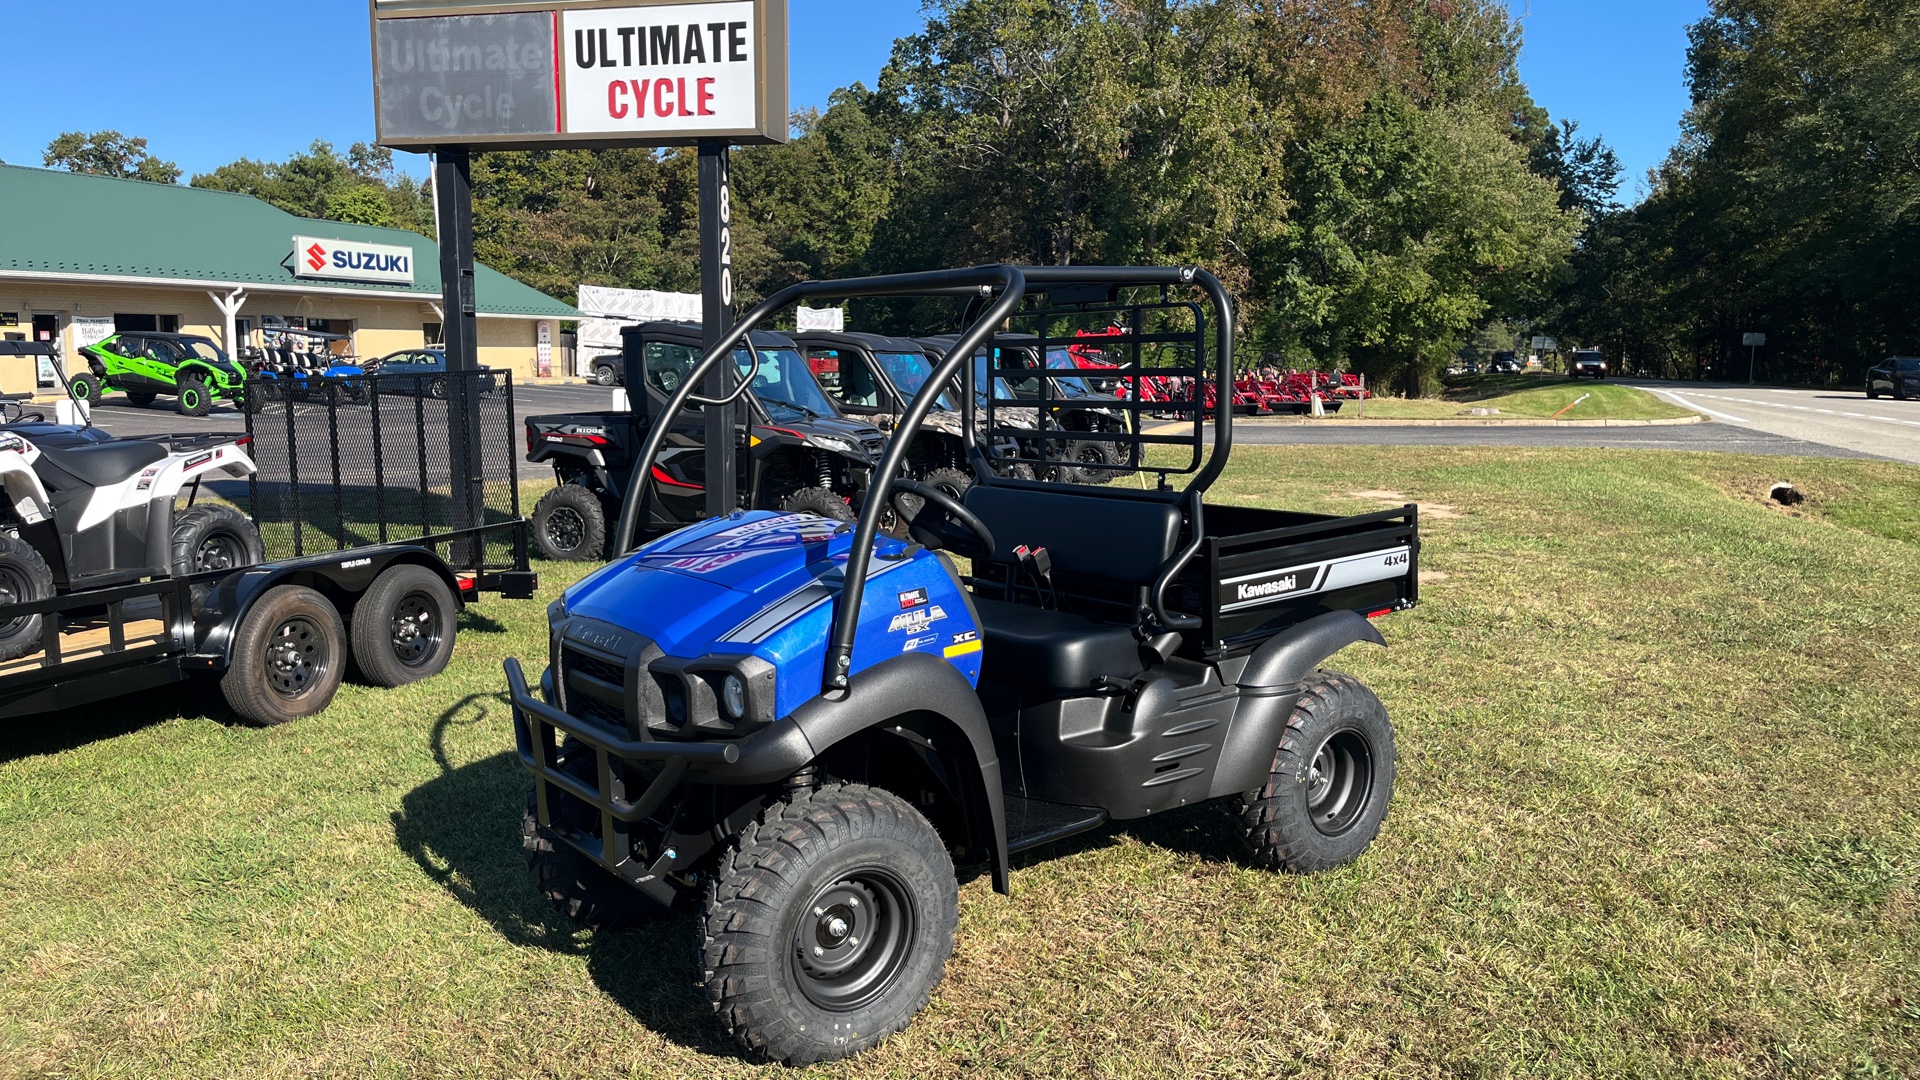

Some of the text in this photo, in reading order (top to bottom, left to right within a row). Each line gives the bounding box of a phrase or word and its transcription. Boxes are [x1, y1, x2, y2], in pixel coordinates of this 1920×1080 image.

[390, 32, 543, 74] Ultimate
[574, 21, 748, 69] ULTIMATE
[420, 84, 515, 126] Cycle
[607, 76, 717, 120] CYCLE
[332, 250, 409, 273] SUZUKI
[1384, 552, 1408, 567] 4x4
[1237, 574, 1297, 600] Kawasaki
[952, 631, 976, 644] XC
